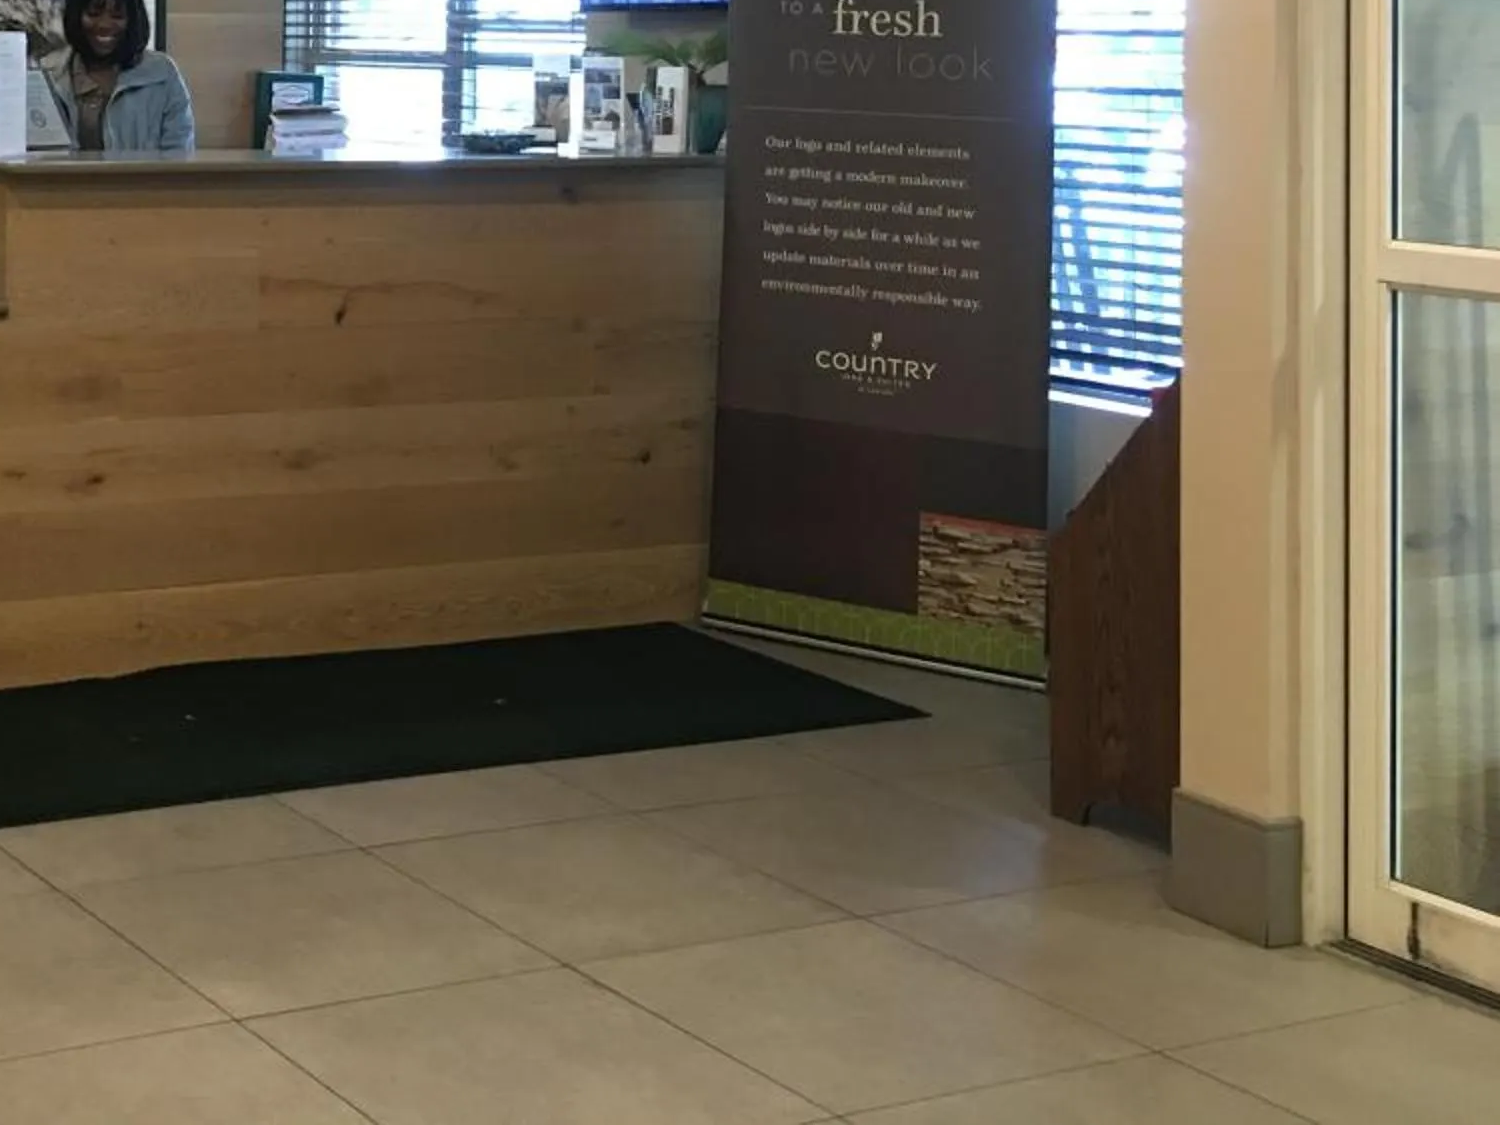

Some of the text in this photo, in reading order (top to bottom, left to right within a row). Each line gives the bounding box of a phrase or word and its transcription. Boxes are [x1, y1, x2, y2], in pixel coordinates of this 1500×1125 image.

[811, 2, 824, 15] A
[788, 42, 994, 82] new look
[764, 136, 792, 150] Our
[825, 140, 851, 153] and
[855, 140, 904, 156] related
[907, 142, 970, 160] elements
[764, 166, 785, 177] are
[788, 166, 831, 183] getting
[834, 170, 843, 181] a
[845, 170, 897, 185] modern
[764, 192, 976, 220] You may notice our old and new
[763, 219, 981, 251] logos side by side for a while as we
[763, 249, 980, 280] update materials over time in an
[761, 278, 868, 302] environmentally
[872, 288, 949, 307] responsible
